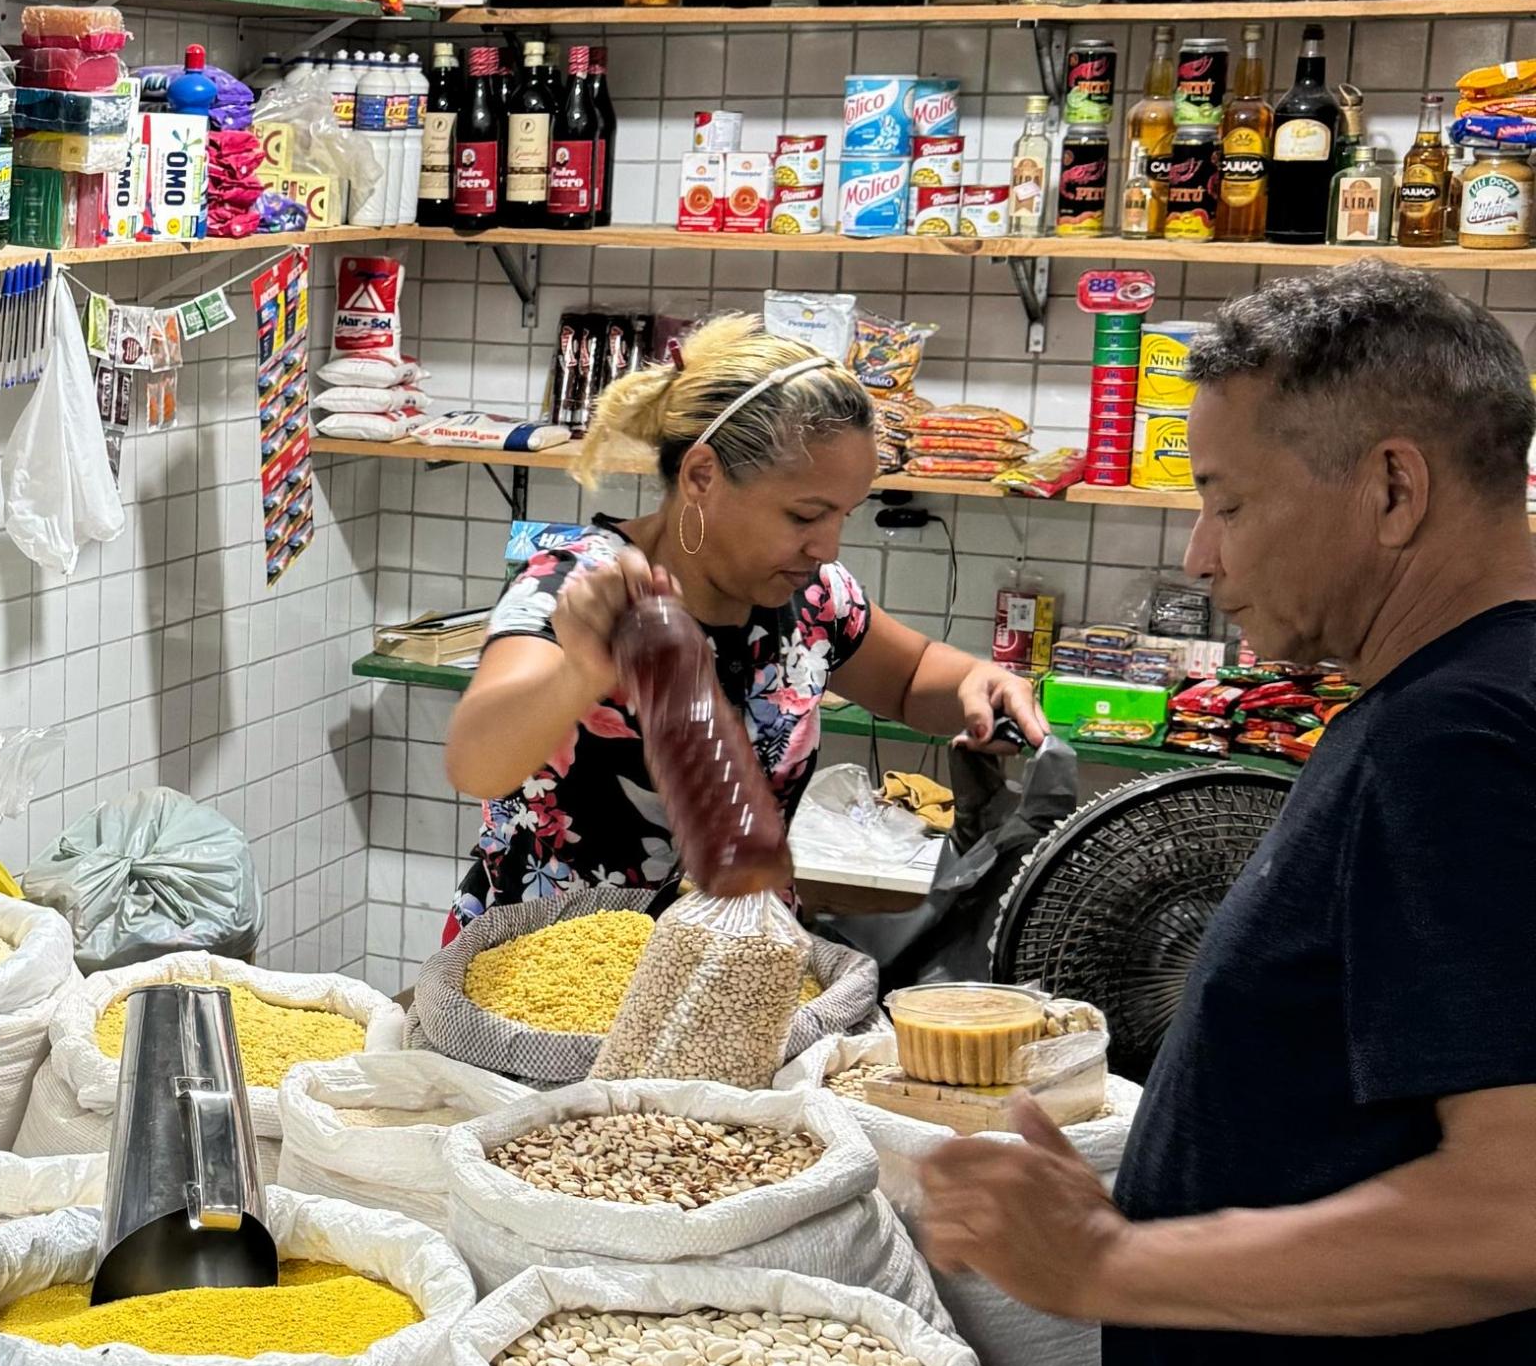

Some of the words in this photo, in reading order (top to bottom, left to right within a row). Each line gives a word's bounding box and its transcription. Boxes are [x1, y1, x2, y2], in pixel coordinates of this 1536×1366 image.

[164, 152, 189, 207] OMO
[845, 173, 901, 211] Molico
[1343, 196, 1375, 210] LIRA
